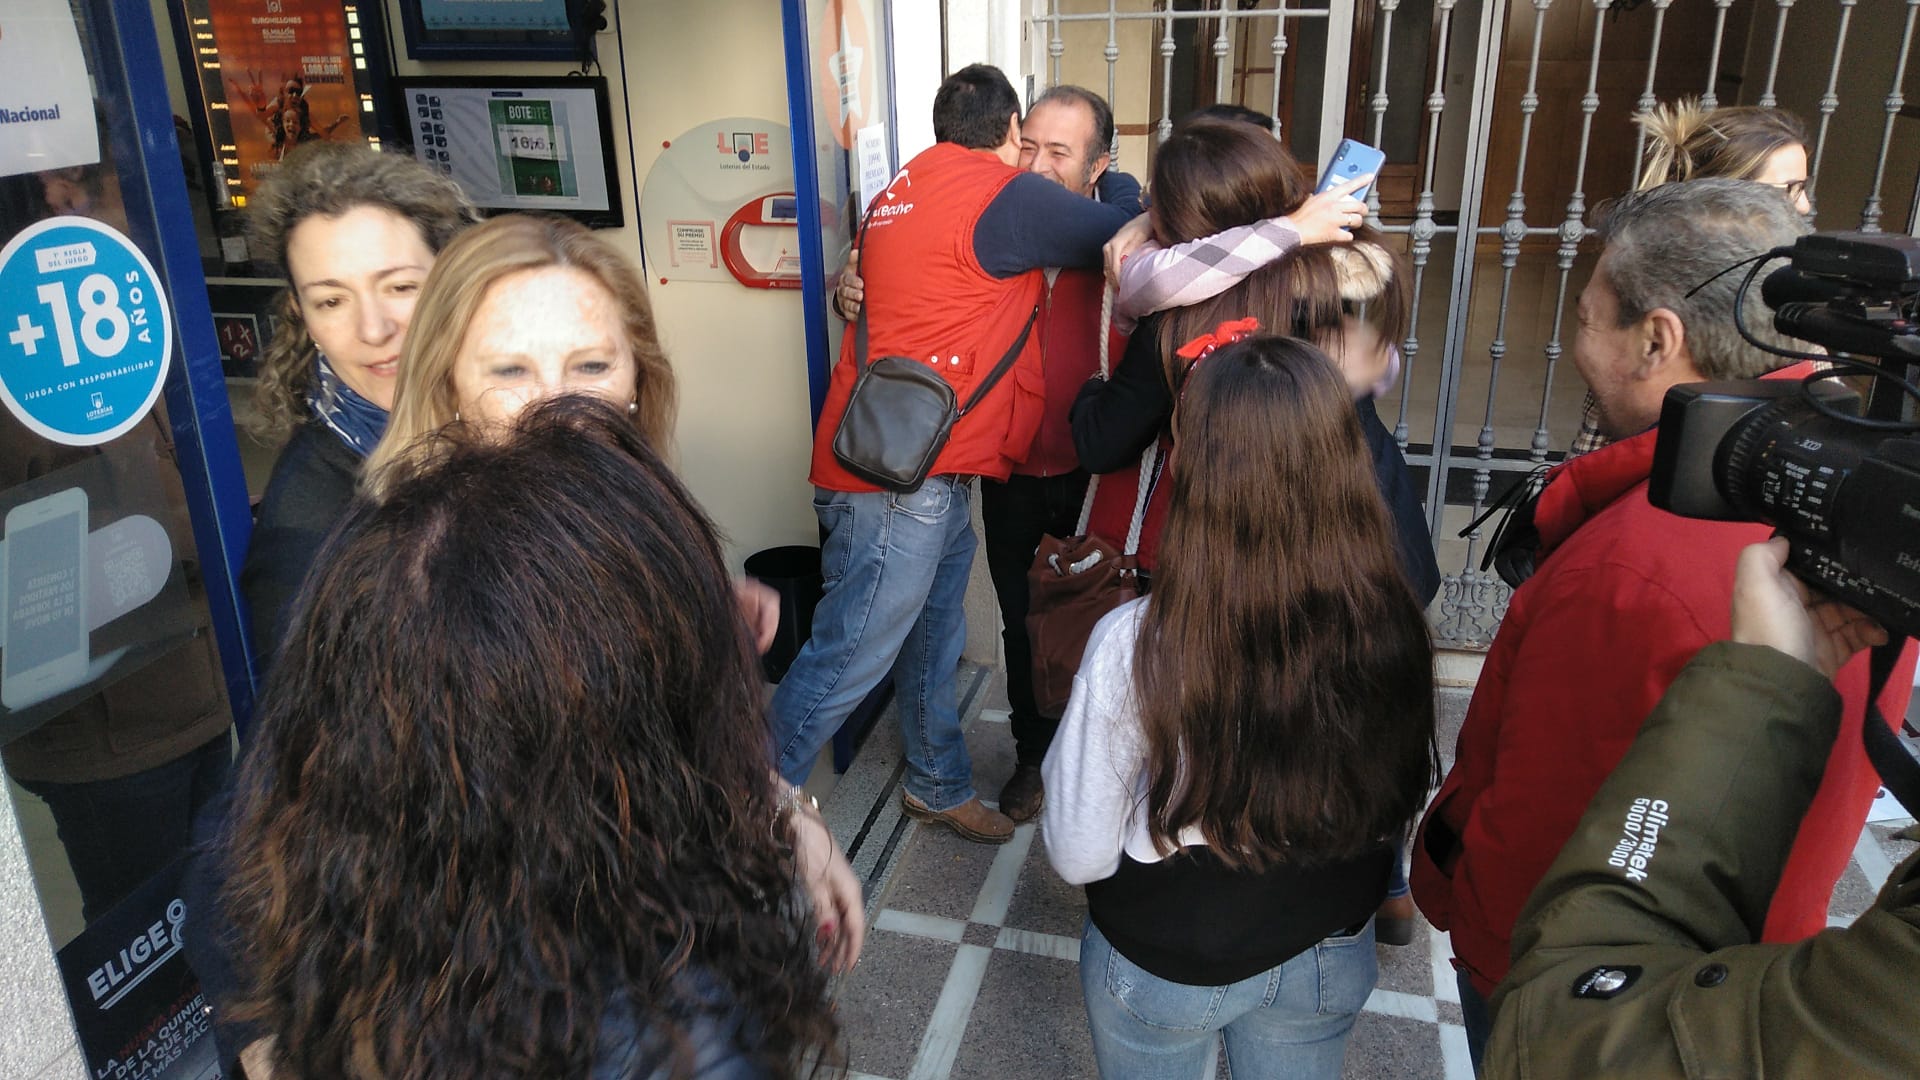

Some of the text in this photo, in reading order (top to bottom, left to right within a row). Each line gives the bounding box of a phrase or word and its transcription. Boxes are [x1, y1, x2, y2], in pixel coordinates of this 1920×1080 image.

[0, 104, 60, 124] Nacional
[8, 273, 130, 367] +18
[125, 270, 152, 344] AÑOS
[25, 359, 155, 401] JUEGA CON RESPONSABILIDAD
[1608, 797, 1650, 867] 5000/3000
[1626, 799, 1669, 882] climatek
[115, 1055, 137, 1080] DE
[138, 1040, 158, 1060] LA
[154, 1029, 183, 1060] QUE
[97, 1058, 119, 1080] LA
